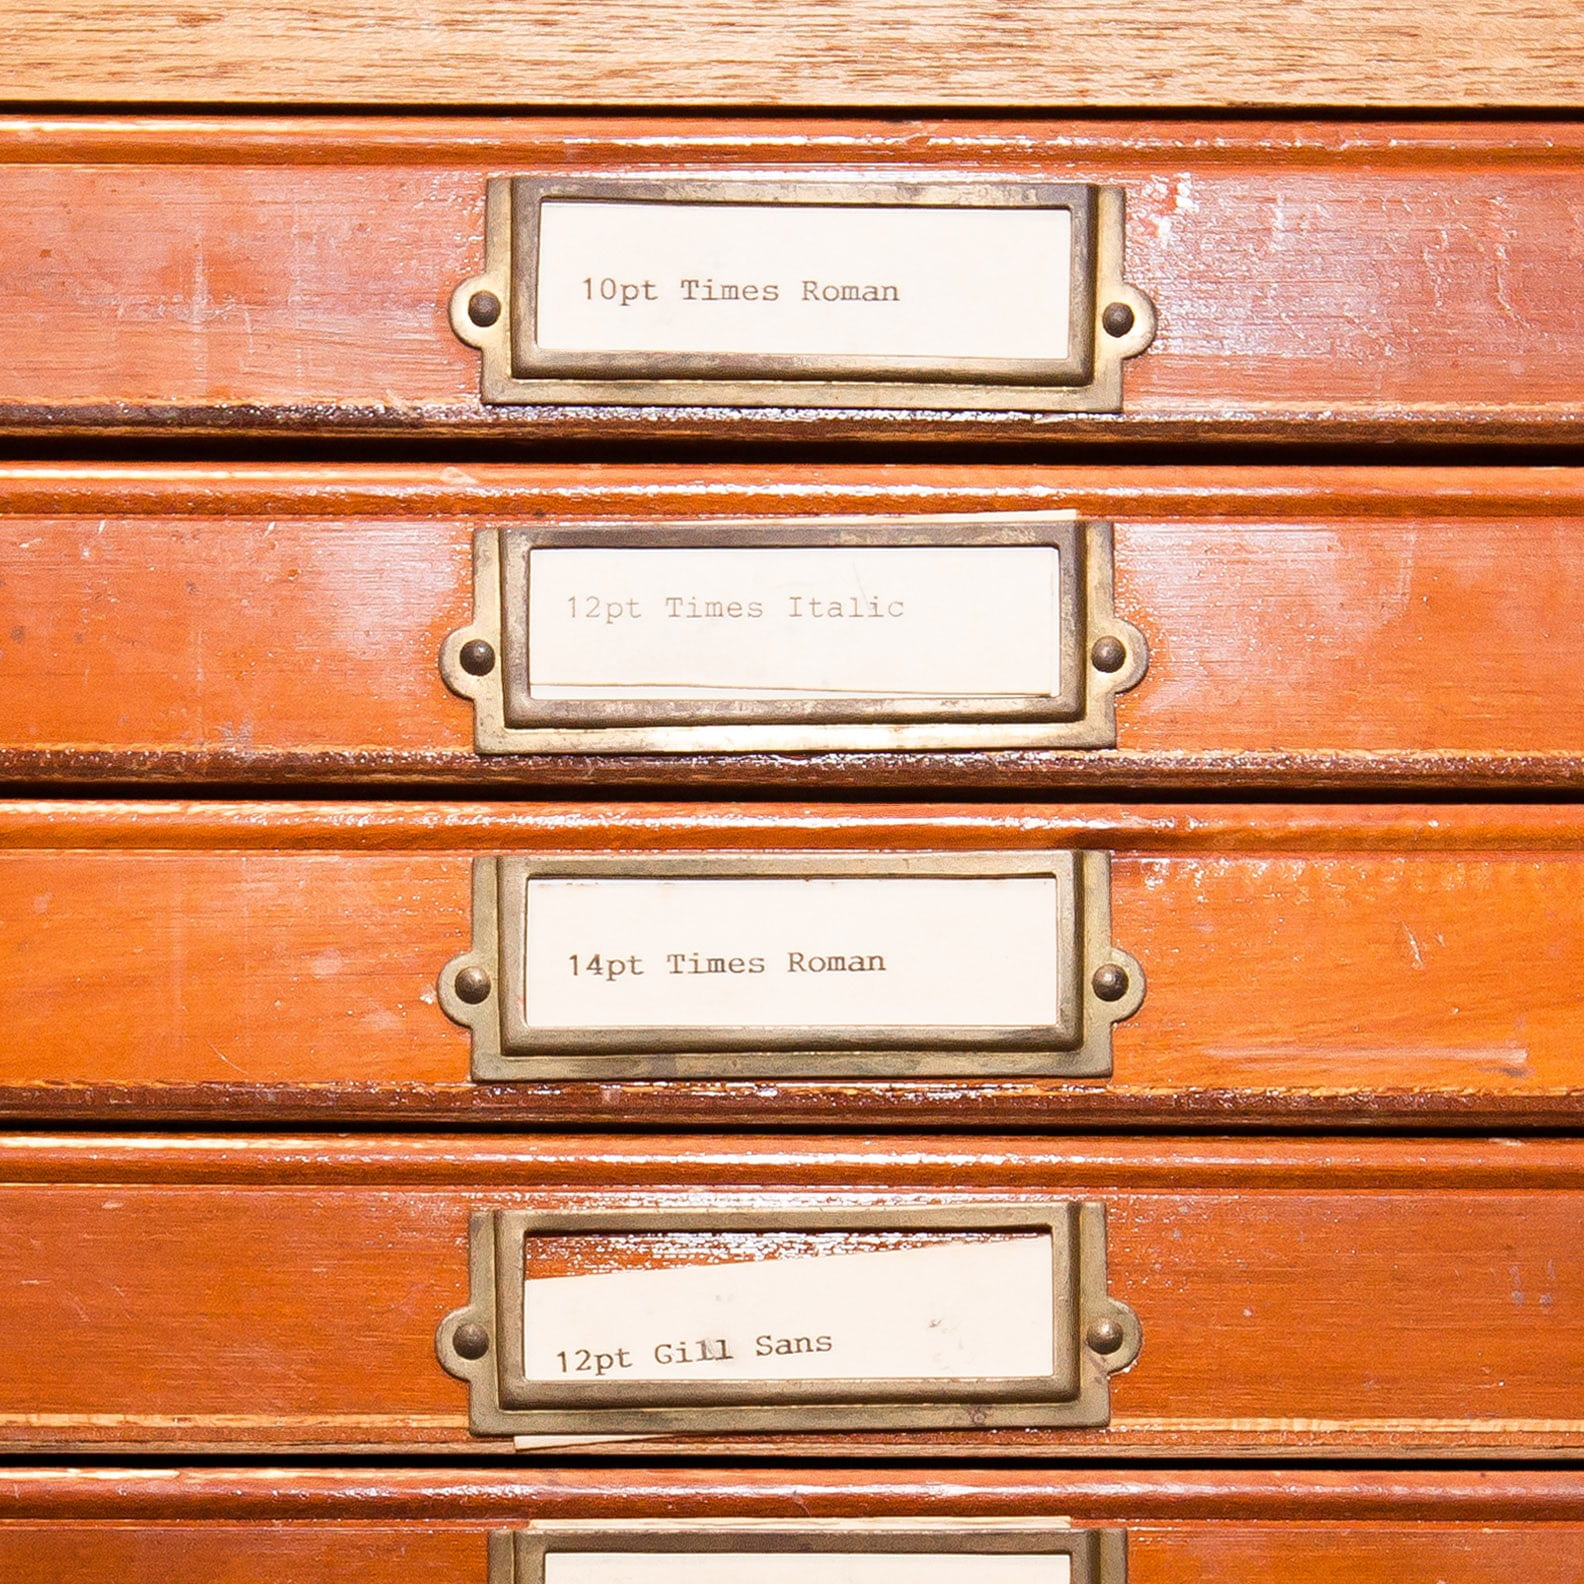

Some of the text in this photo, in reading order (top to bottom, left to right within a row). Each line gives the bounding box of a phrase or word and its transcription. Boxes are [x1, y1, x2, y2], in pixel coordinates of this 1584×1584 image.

[583, 277, 901, 307] 10pt Times Roman
[567, 595, 904, 625] 12pt Times Italic
[568, 951, 887, 982] 14pt Times Roman
[556, 1334, 833, 1376] 12pt Gill Sans
